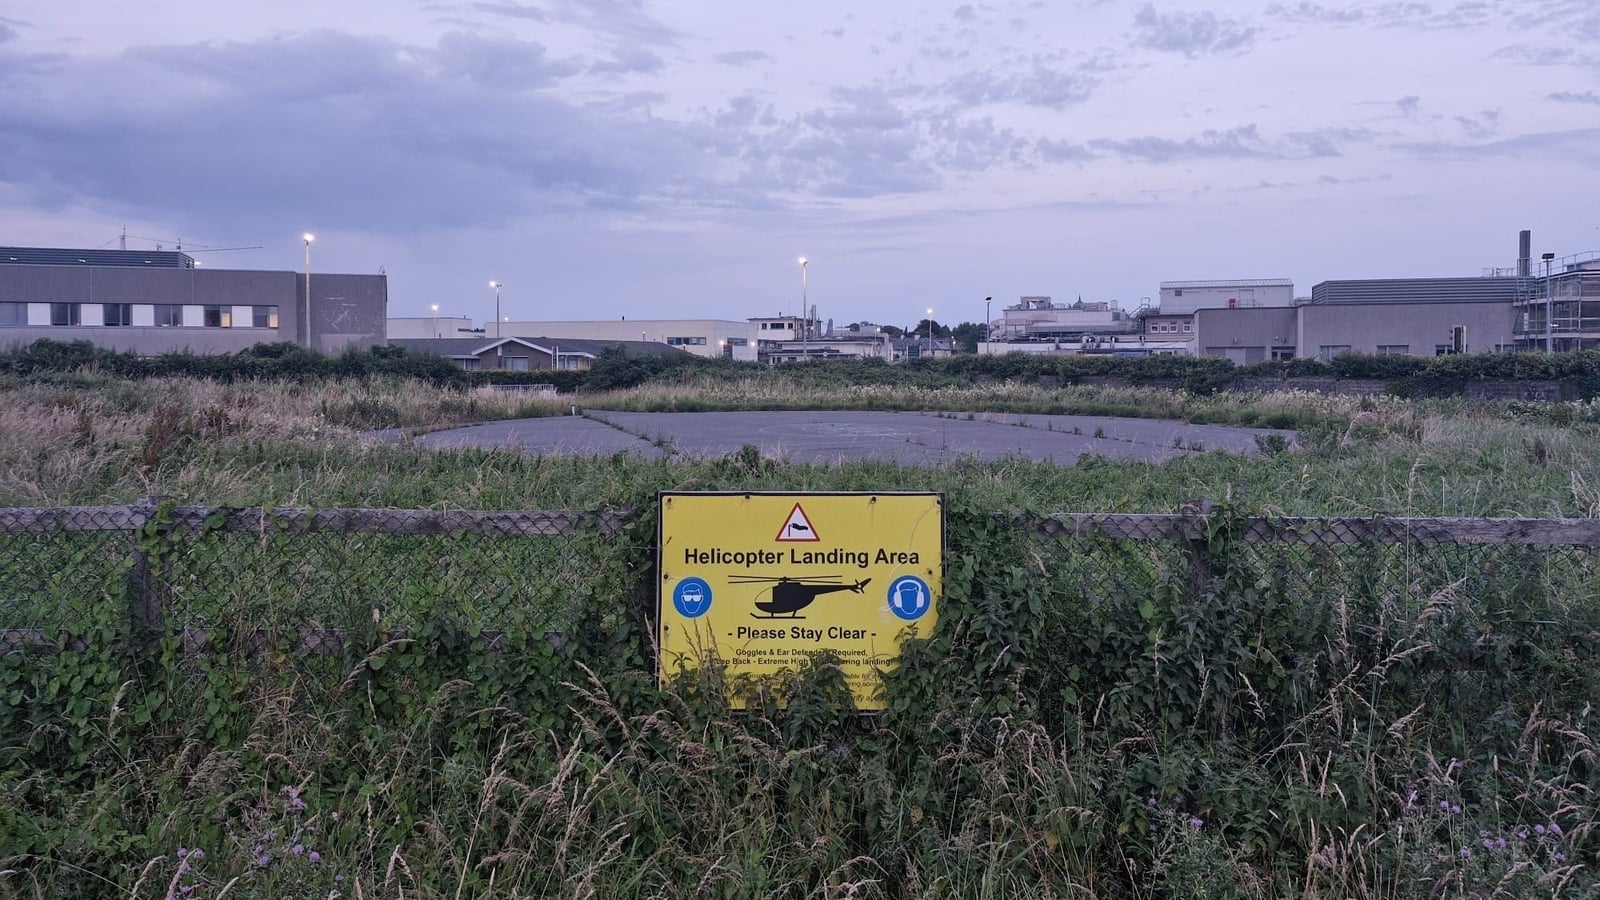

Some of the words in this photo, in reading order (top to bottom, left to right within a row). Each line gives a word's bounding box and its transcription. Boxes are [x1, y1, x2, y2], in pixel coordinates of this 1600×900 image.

[684, 548, 784, 567] Helicopter
[790, 548, 869, 568] Landing
[875, 548, 919, 564] Area
[737, 626, 786, 639] Please
[791, 626, 822, 642] Stay
[827, 626, 867, 639] Clear
[735, 648, 767, 657] Goggles
[769, 648, 775, 656] &
[777, 648, 789, 656] Ear
[791, 648, 830, 656] Defender
[832, 648, 868, 657] Required,
[712, 658, 730, 666] eep
[732, 657, 751, 665] Back
[758, 657, 788, 665] Extreme
